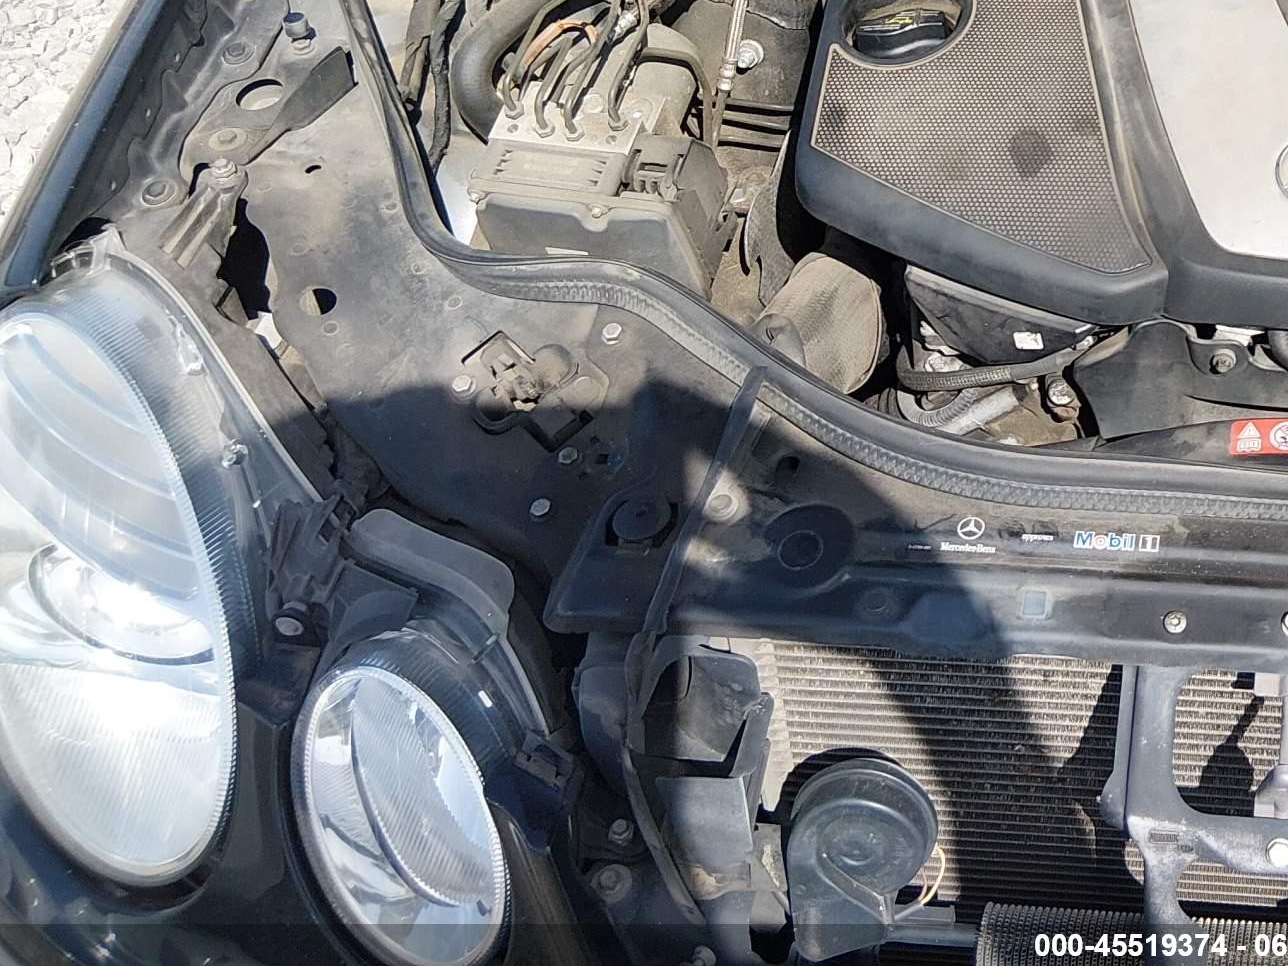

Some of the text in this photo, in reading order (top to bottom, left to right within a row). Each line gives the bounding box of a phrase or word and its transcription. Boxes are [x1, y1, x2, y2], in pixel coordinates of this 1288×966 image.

[940, 541, 997, 553] Mercedes-Benz
[1073, 530, 1161, 553] Mobil 1
